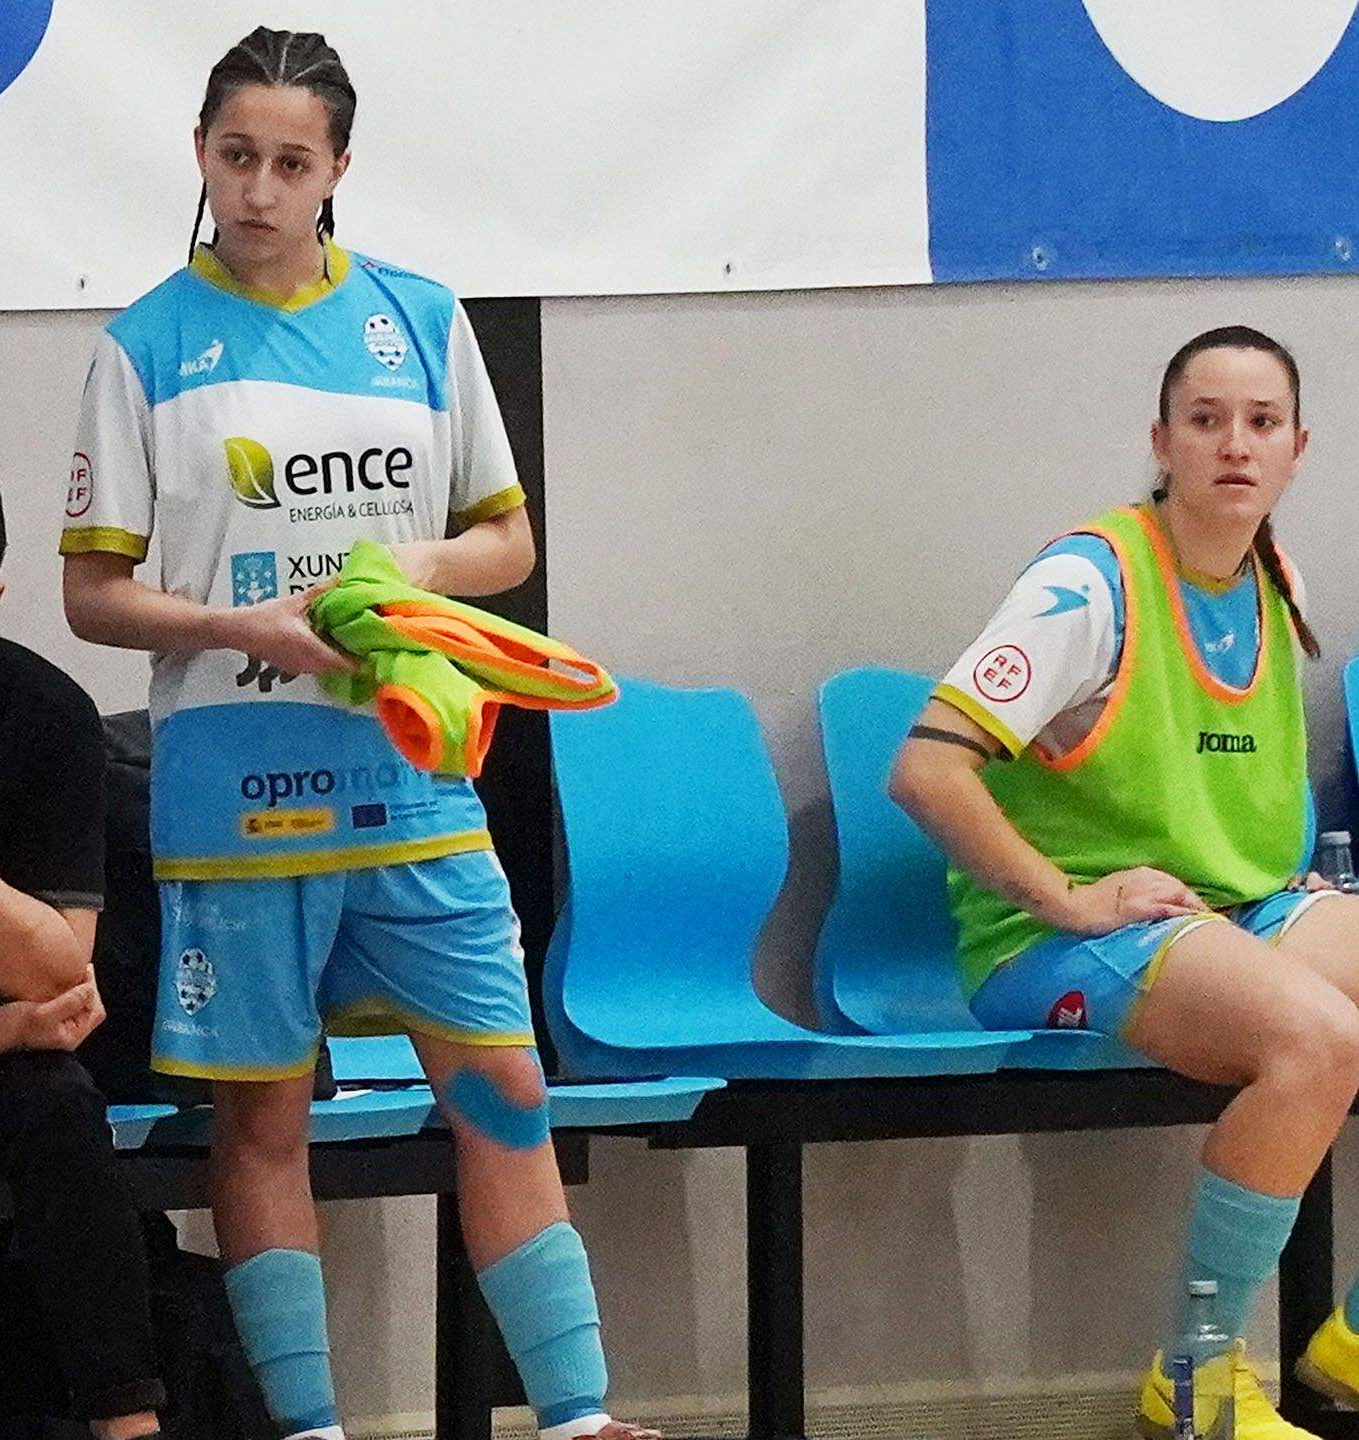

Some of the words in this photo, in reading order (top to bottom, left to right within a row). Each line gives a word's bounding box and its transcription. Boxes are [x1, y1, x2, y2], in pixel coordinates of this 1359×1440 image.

[285, 447, 413, 495] ence
[289, 502, 345, 523] ENERGÍA
[347, 503, 356, 518] &
[287, 552, 350, 579] XUN
